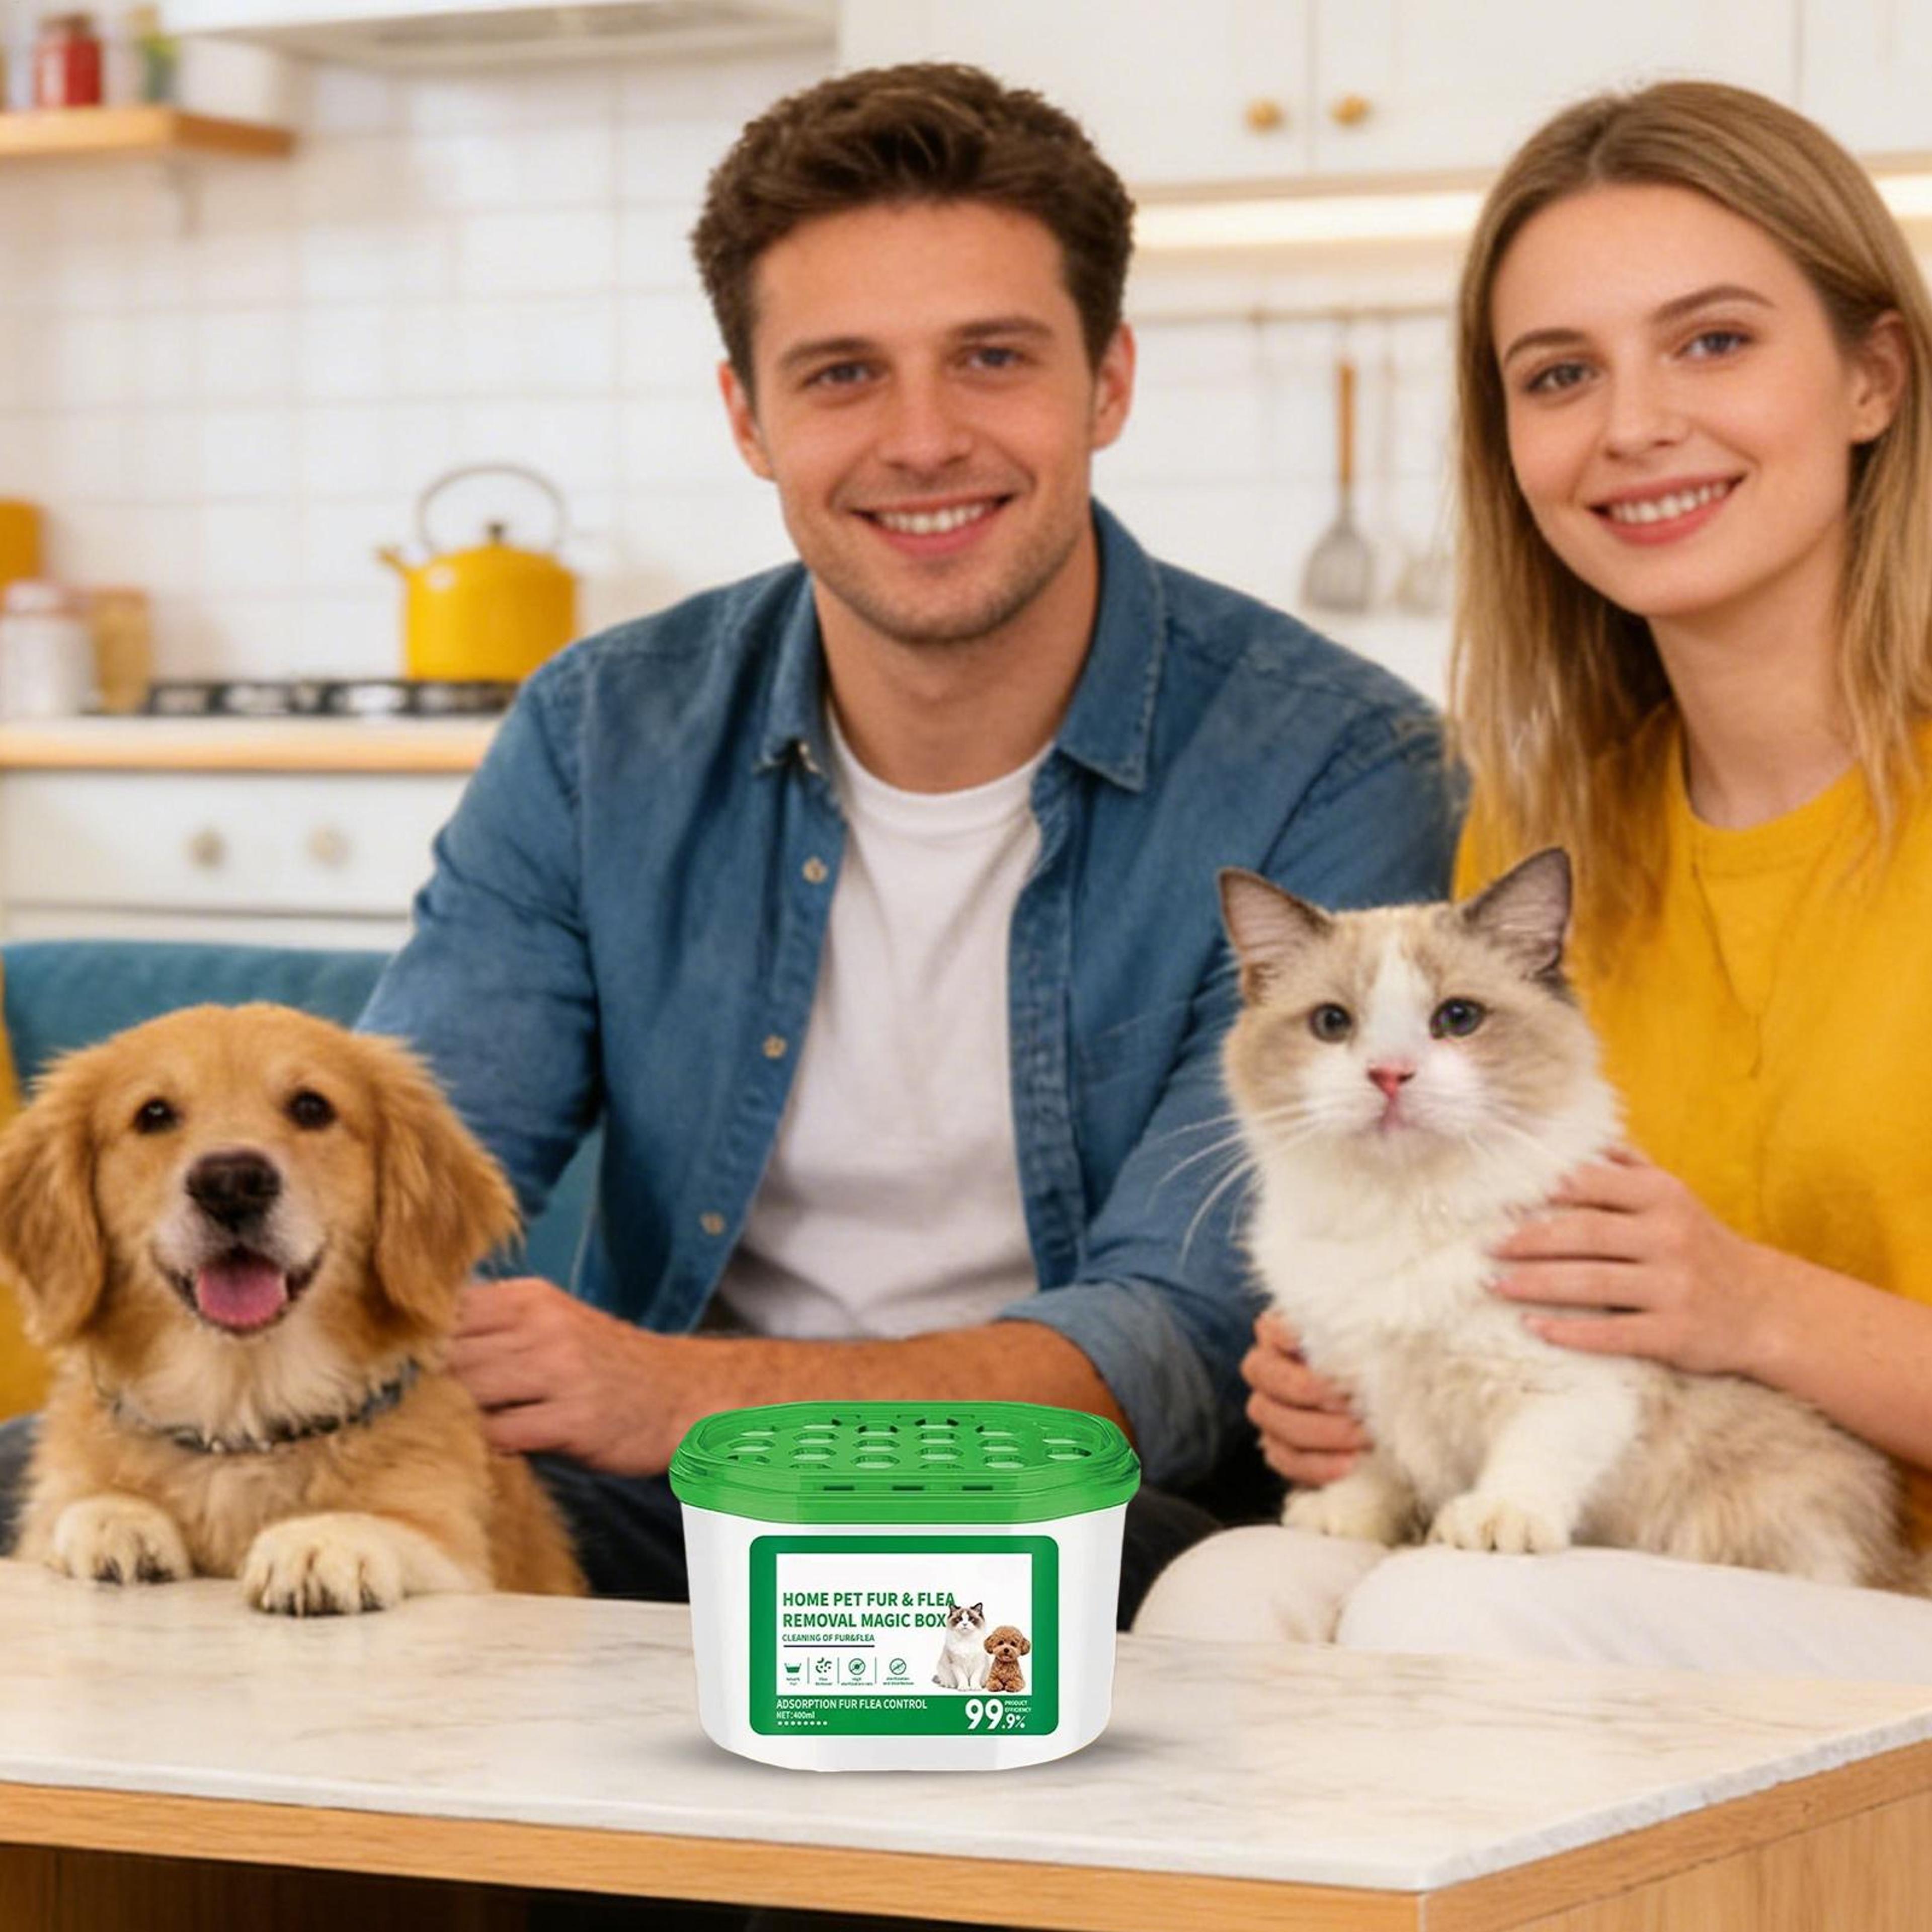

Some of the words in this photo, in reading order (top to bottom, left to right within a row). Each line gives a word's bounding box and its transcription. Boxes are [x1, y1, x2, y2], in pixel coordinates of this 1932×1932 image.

[782, 1592, 829, 1606] HOME
[834, 1592, 863, 1606] PET
[867, 1592, 898, 1606] FUR
[902, 1592, 914, 1606] &
[917, 1592, 955, 1606] FLEA
[783, 1614, 857, 1627] REMOVAL
[861, 1614, 911, 1627] MAGIC
[915, 1614, 946, 1627] BOX
[776, 1699, 837, 1709] ADSORPTION
[839, 1699, 857, 1709] FUR
[859, 1699, 882, 1709] FLEA
[883, 1699, 927, 1709] CONTROL
